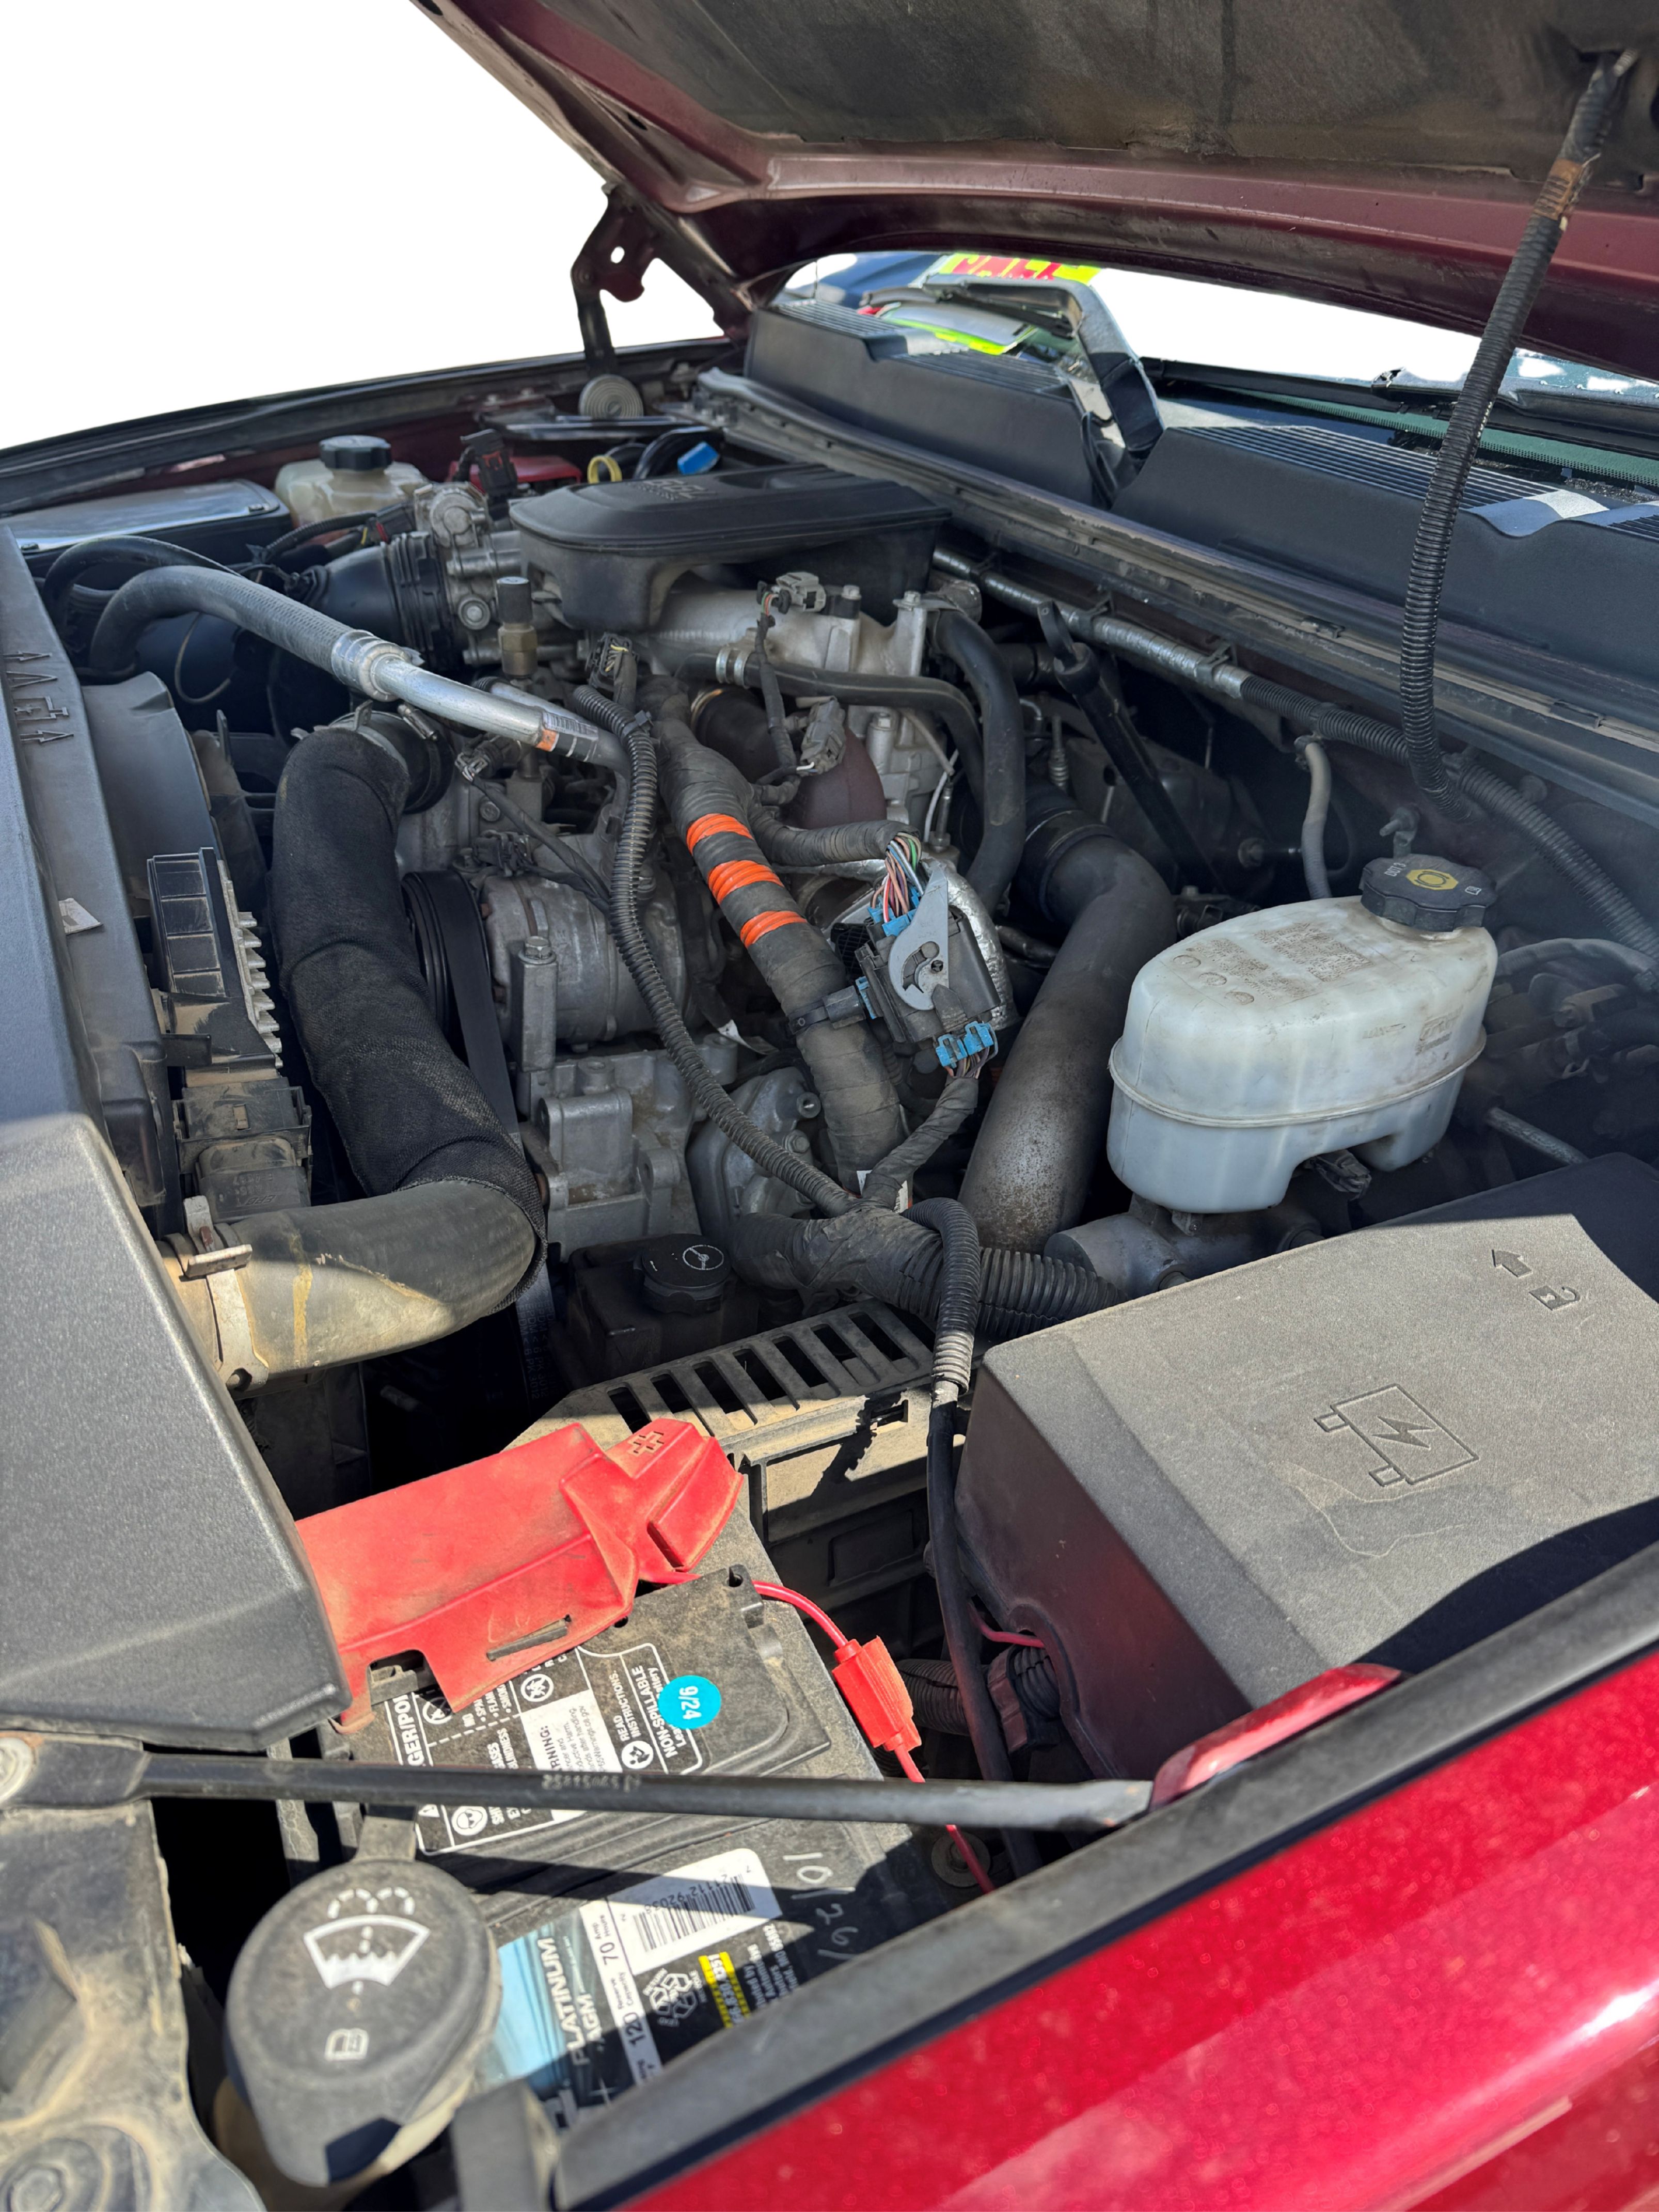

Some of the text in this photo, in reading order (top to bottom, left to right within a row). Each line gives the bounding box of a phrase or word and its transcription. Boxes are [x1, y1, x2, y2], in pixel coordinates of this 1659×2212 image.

[1383, 865, 1402, 877] DOT
[516, 1305, 528, 1335] EPDM
[526, 1303, 537, 1333] EPDM
[485, 1691, 499, 1713] FLAM
[496, 1684, 512, 1708] SMOK
[608, 1670, 641, 1737] INSTRUCTIONS.
[678, 1685, 702, 1720] 9/24
[462, 1713, 476, 1727] NO
[631, 1665, 678, 1758] NON-SPILLABLE
[612, 1715, 630, 1742] READ
[540, 1725, 562, 1771] RNING:
[557, 1737, 566, 1751] and
[570, 1743, 583, 1767] oductive
[579, 1737, 589, 1751] after
[584, 1752, 594, 1767] ands
[592, 1922, 602, 1940] Amp
[599, 1915, 610, 1937] Hours
[599, 1942, 619, 1965] 70
[537, 1939, 591, 2064] PLATINUM
[576, 1994, 604, 2042] AGM
[623, 2012, 645, 2046] 120
